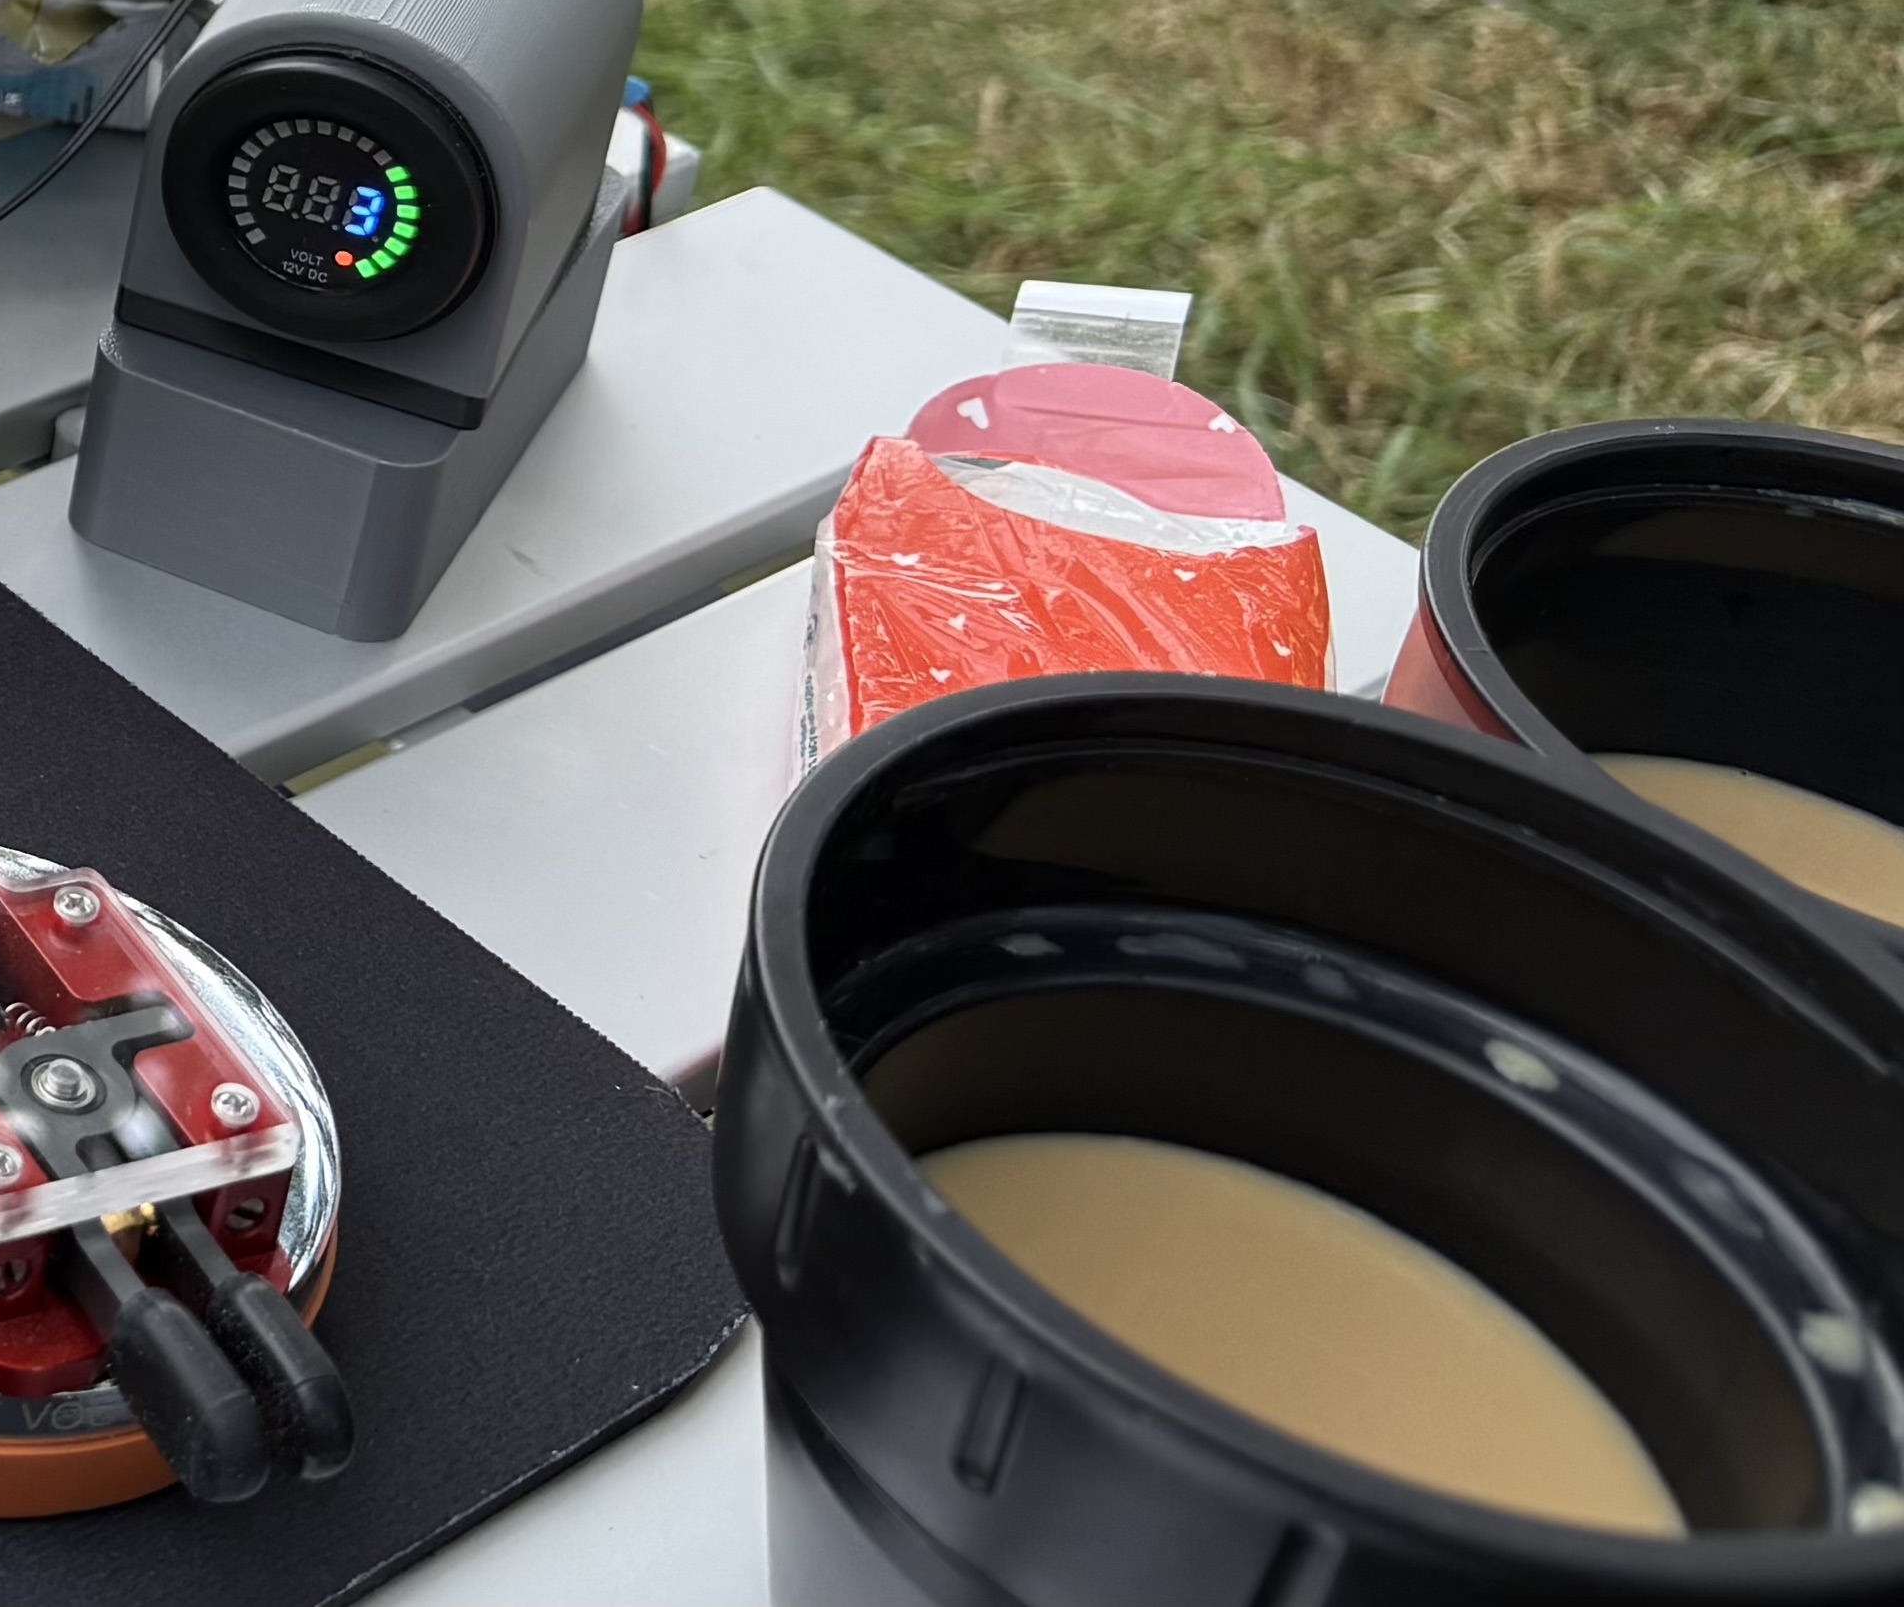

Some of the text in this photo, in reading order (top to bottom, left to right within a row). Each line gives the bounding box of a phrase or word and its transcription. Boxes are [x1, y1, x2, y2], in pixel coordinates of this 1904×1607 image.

[290, 247, 325, 266] VOLT
[281, 260, 329, 284] 12V DC
